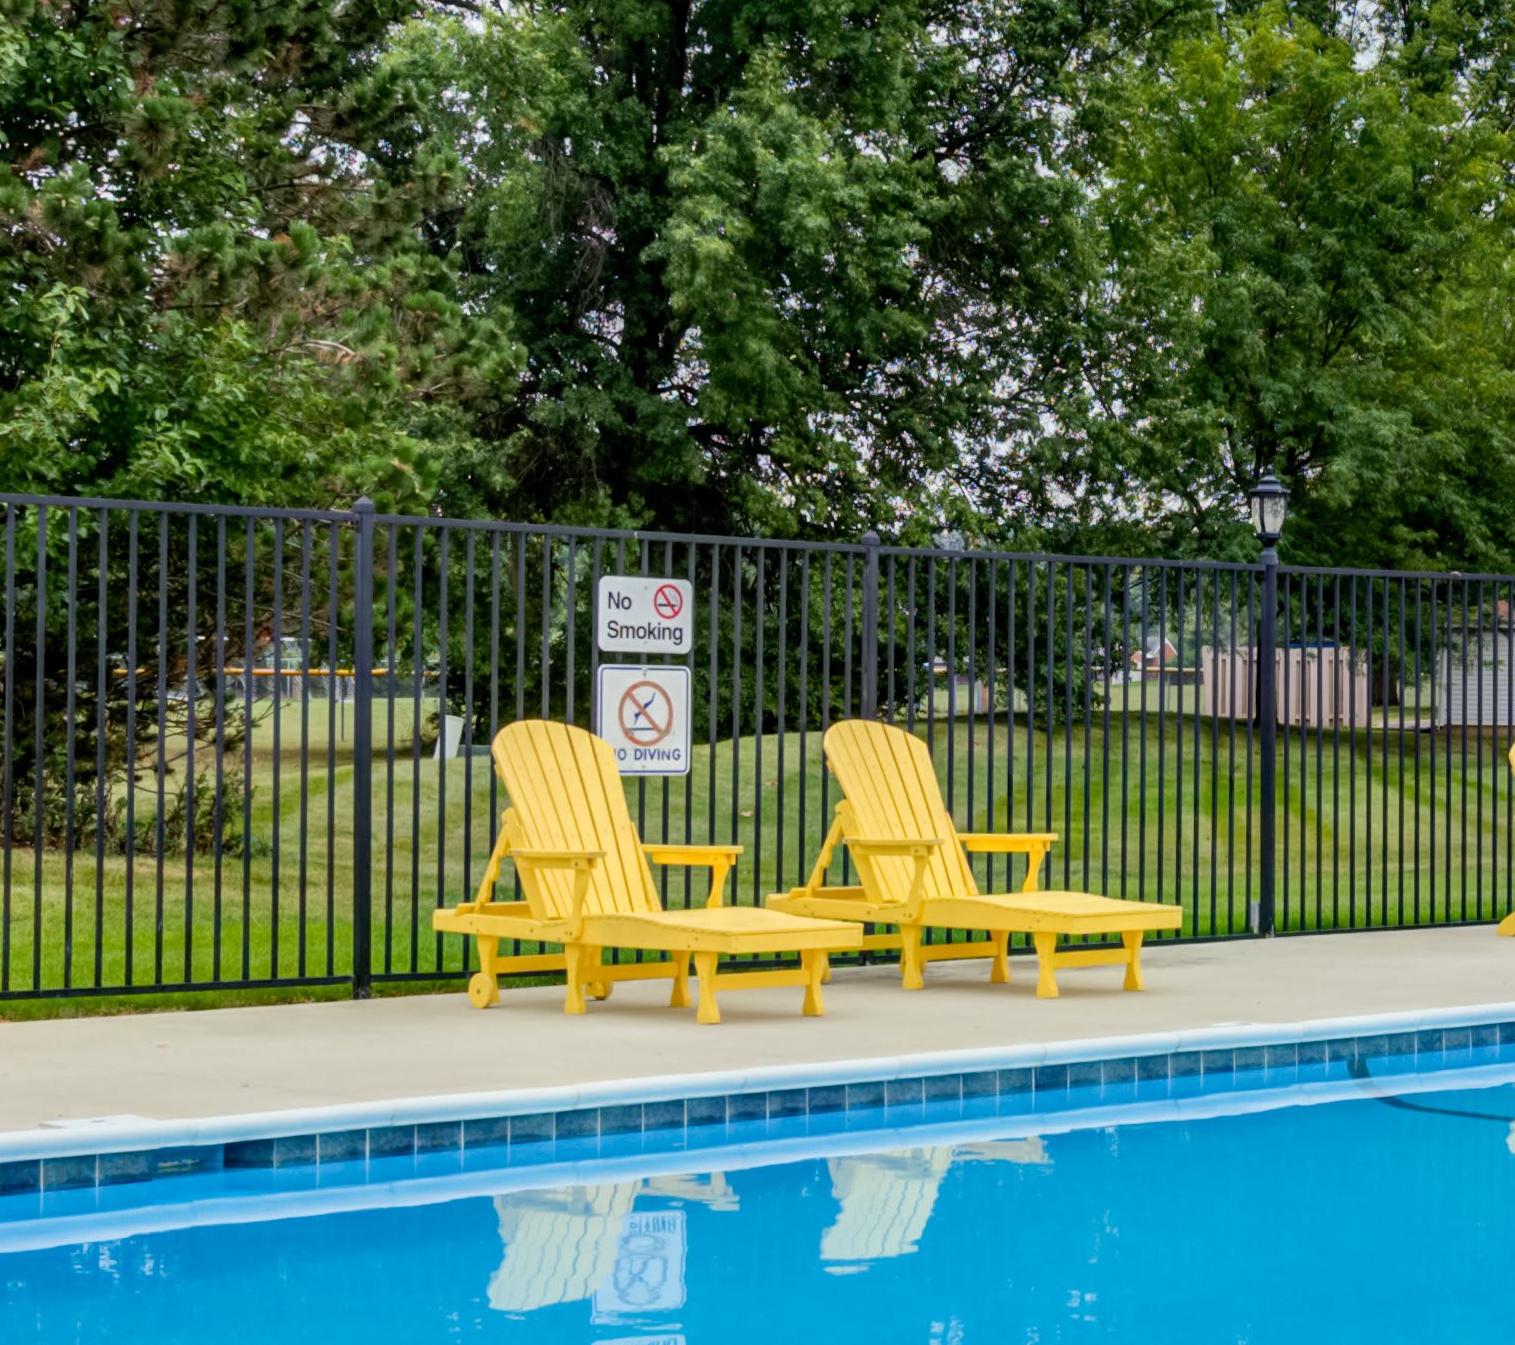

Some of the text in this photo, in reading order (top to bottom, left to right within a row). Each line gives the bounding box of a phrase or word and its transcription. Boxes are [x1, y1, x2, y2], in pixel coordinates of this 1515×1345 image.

[607, 591, 632, 610] No
[607, 620, 683, 646] Smoking
[634, 748, 681, 761] DIVING
